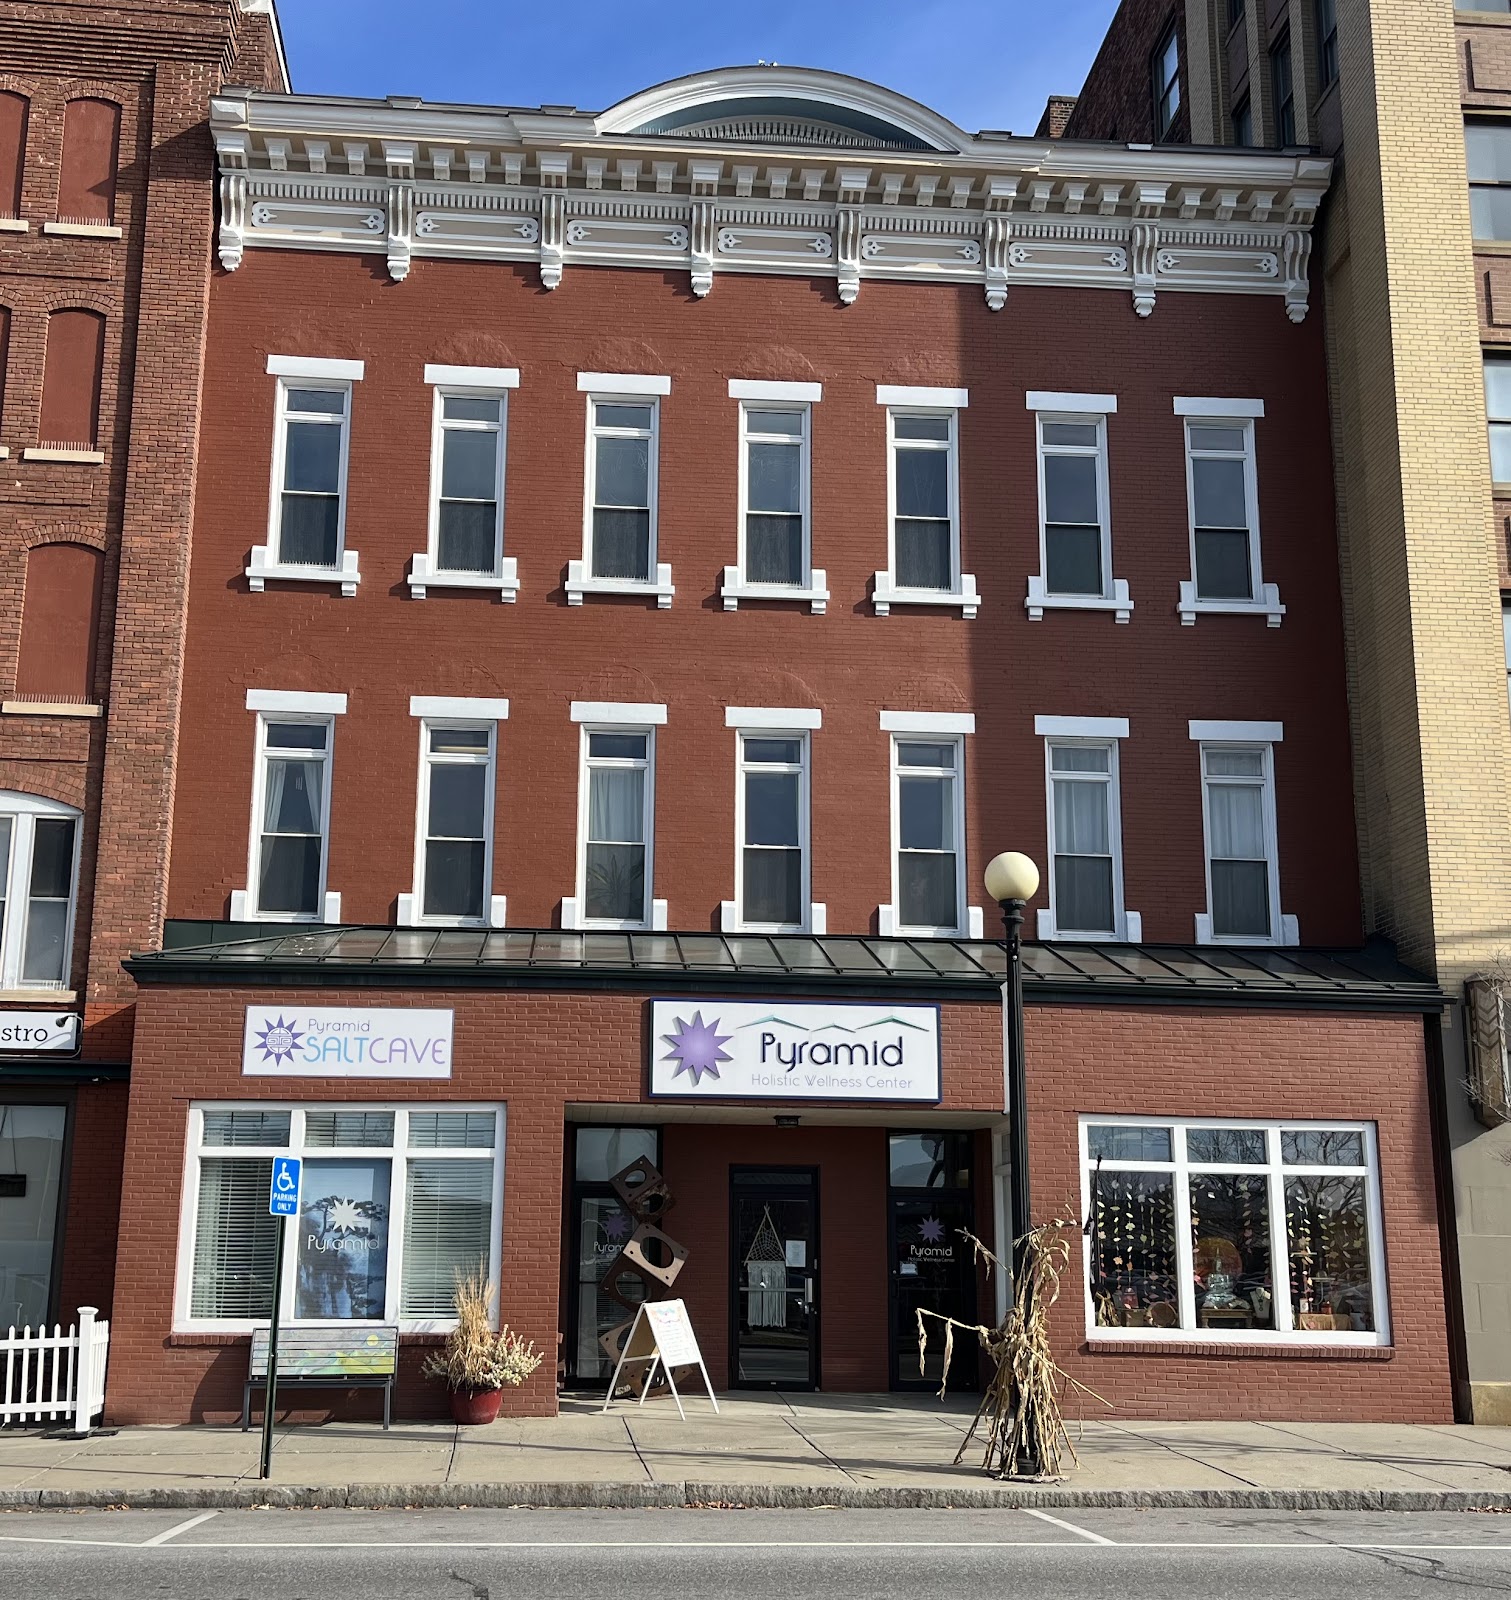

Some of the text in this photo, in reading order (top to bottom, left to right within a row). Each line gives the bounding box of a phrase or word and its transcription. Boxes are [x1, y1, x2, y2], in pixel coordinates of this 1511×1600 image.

[1, 1024, 48, 1042] stro
[308, 1018, 371, 1034] Pyramid
[759, 1032, 904, 1073] Pyramid
[751, 1073, 913, 1089] Holistic Wellness Center
[273, 1192, 297, 1203] PARKING
[277, 1202, 292, 1211] ONLY
[307, 1234, 380, 1254] Pyramid
[593, 1241, 625, 1254] Pyram
[910, 1244, 953, 1258] Pyramid
